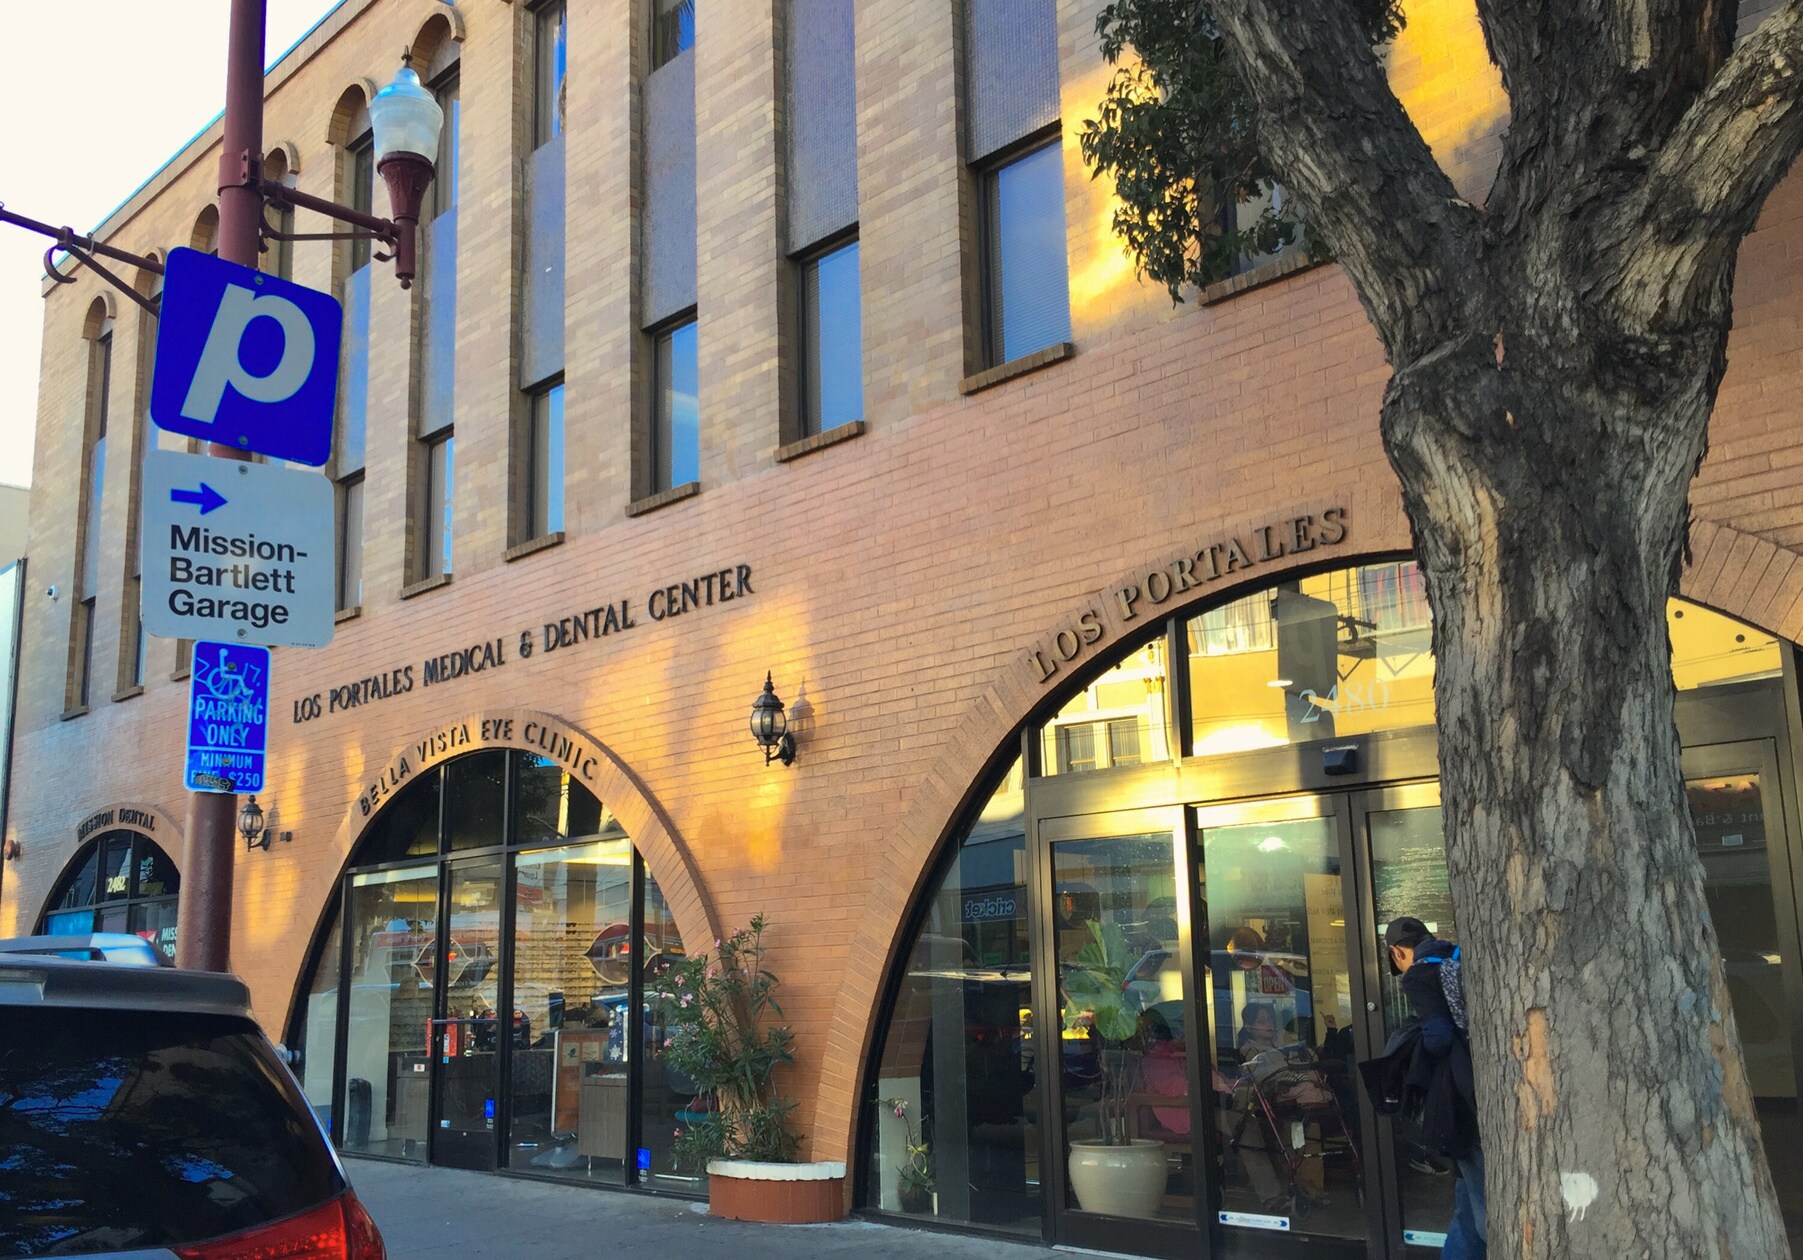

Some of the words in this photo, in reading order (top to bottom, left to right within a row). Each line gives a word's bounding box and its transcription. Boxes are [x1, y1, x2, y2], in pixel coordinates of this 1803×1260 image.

[170, 524, 307, 563] Mission-
[169, 556, 295, 594] Bartlett
[168, 588, 289, 628] Garage
[1028, 610, 1104, 685] LOS
[1113, 507, 1348, 622] PORTALES
[293, 693, 322, 724] LOS
[329, 665, 414, 713] PORTALES
[423, 638, 505, 687] MEDICAL
[519, 630, 533, 659] &
[544, 599, 636, 653] DENTAL
[648, 563, 755, 622] CENTER
[195, 699, 263, 725] PARKING
[1299, 678, 1390, 725] 2480
[208, 723, 250, 747] ONLY
[359, 756, 411, 817] BELLA
[416, 723, 471, 762] VISTA
[480, 718, 514, 741] EYE
[524, 721, 599, 781] CLINIC
[77, 809, 114, 842] MISSION
[118, 808, 156, 831] DENTAL
[161, 926, 178, 942] MISS
